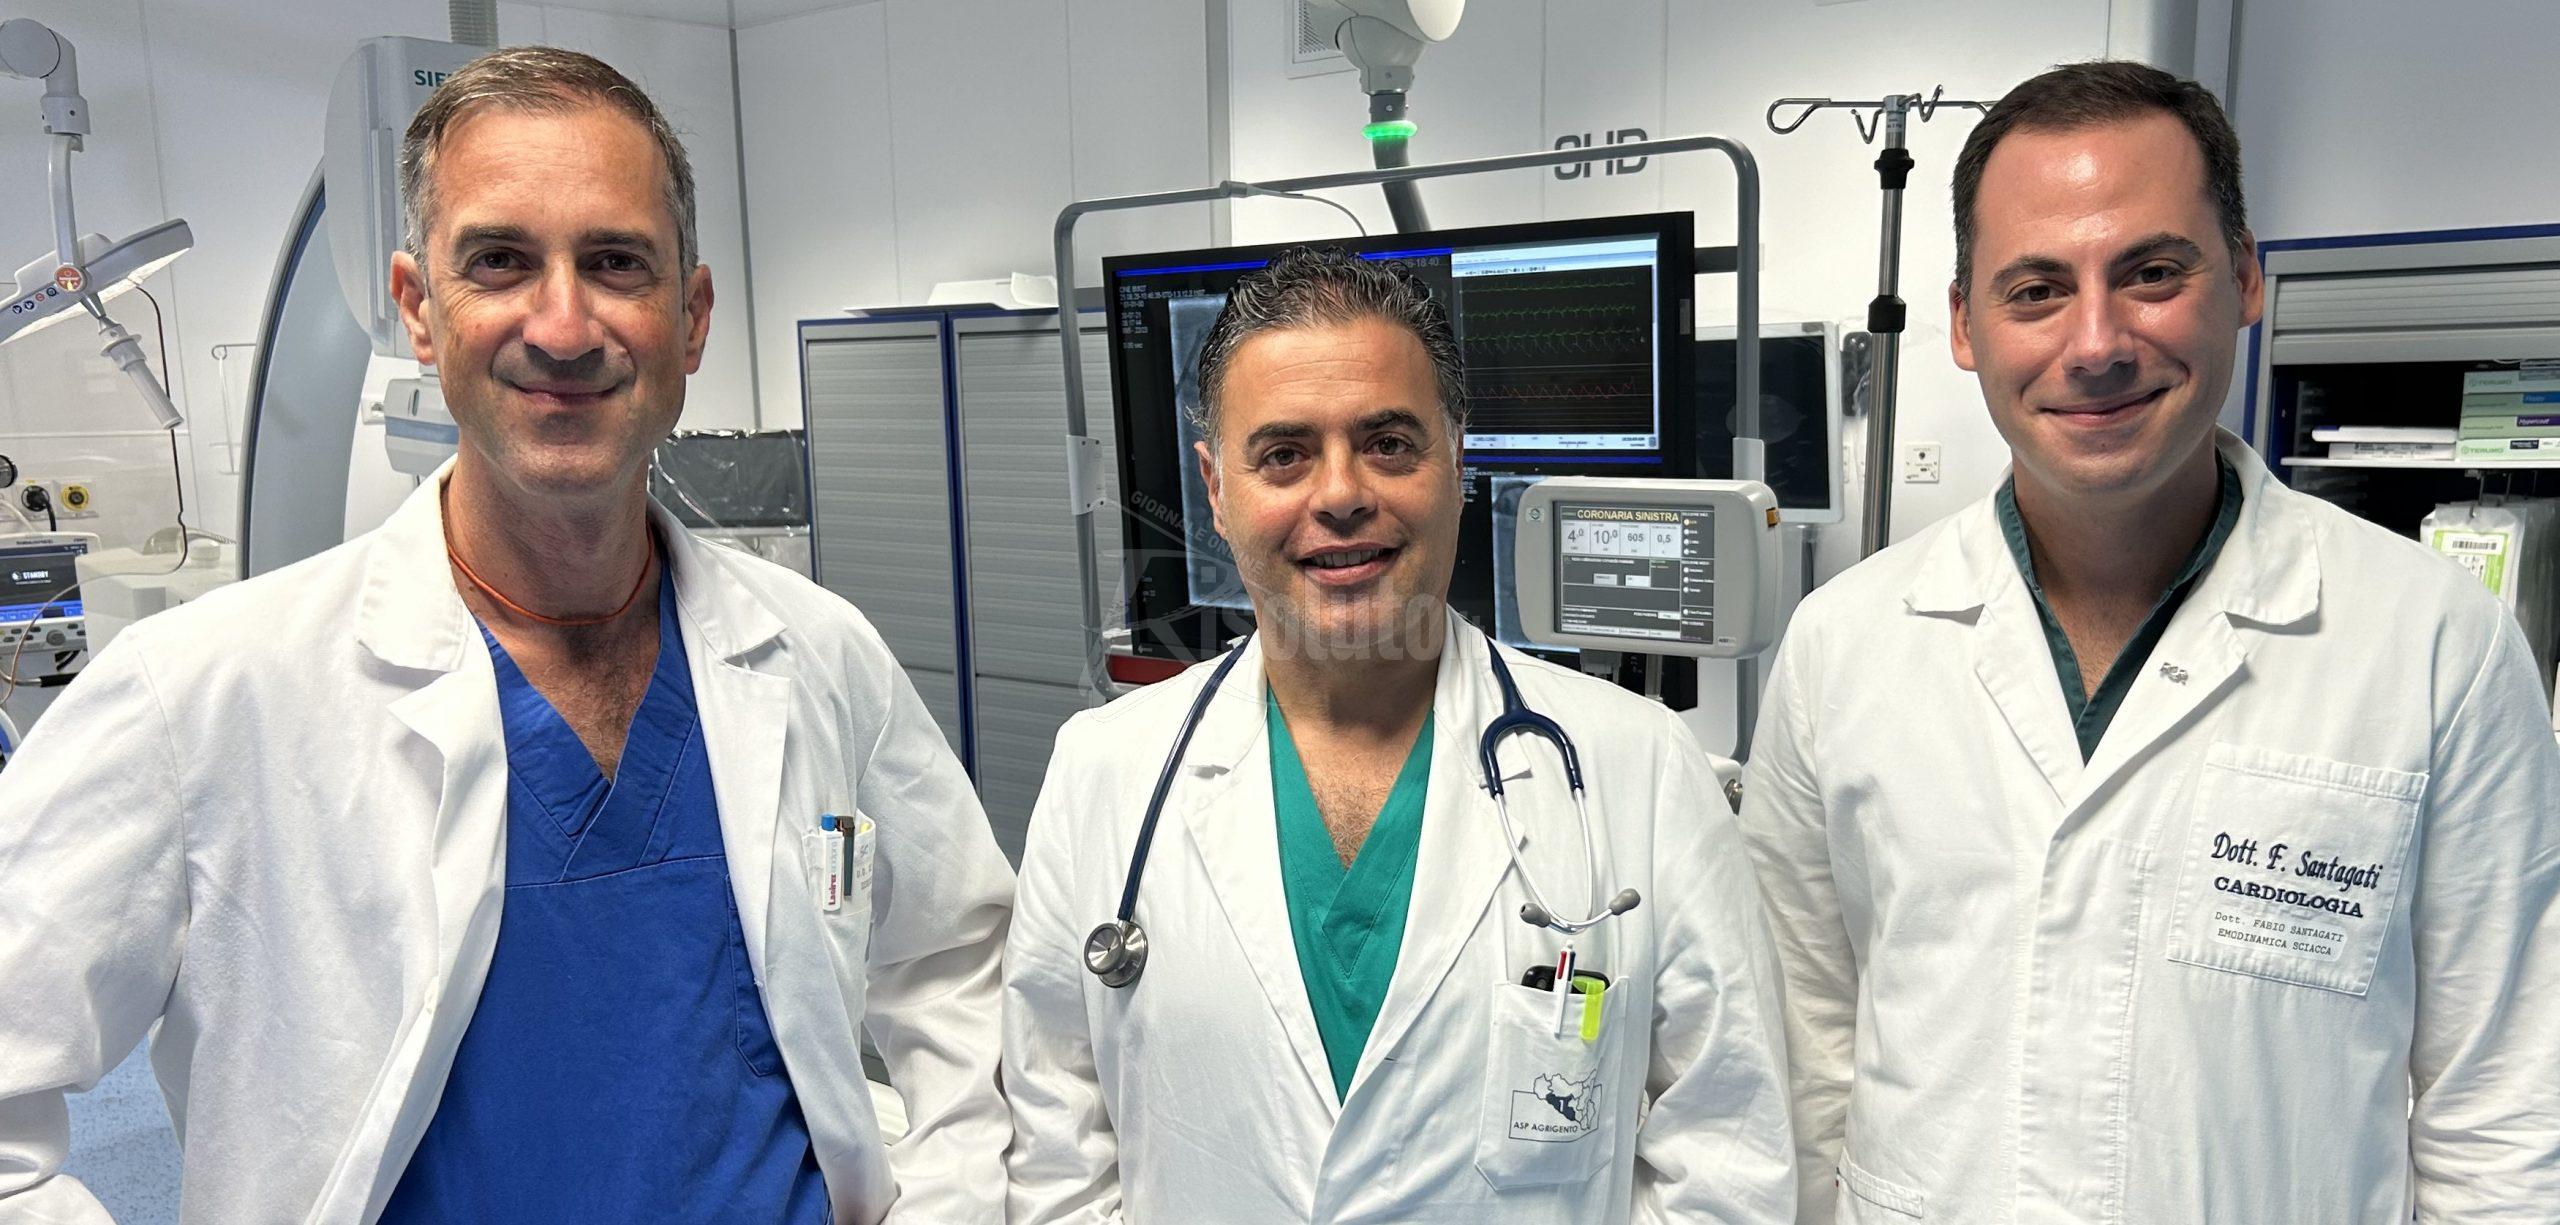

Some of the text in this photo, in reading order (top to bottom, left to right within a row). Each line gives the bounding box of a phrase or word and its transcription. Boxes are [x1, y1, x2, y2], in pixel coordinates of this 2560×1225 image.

[1577, 510, 1633, 520] CORONARIA
[1635, 512, 1680, 522] SINISTRA
[1627, 533, 1644, 542] 605
[2211, 831, 2384, 892] Dott. F. Santagati
[2213, 876, 2364, 918] CARDIOLOGIA
[2214, 912, 2345, 943] Dott. FABIO SANTAGATI
[2217, 928, 2332, 956] EMODINAMICA SCIACCA
[1513, 1121, 1579, 1134] ASP AGRIGENTO
